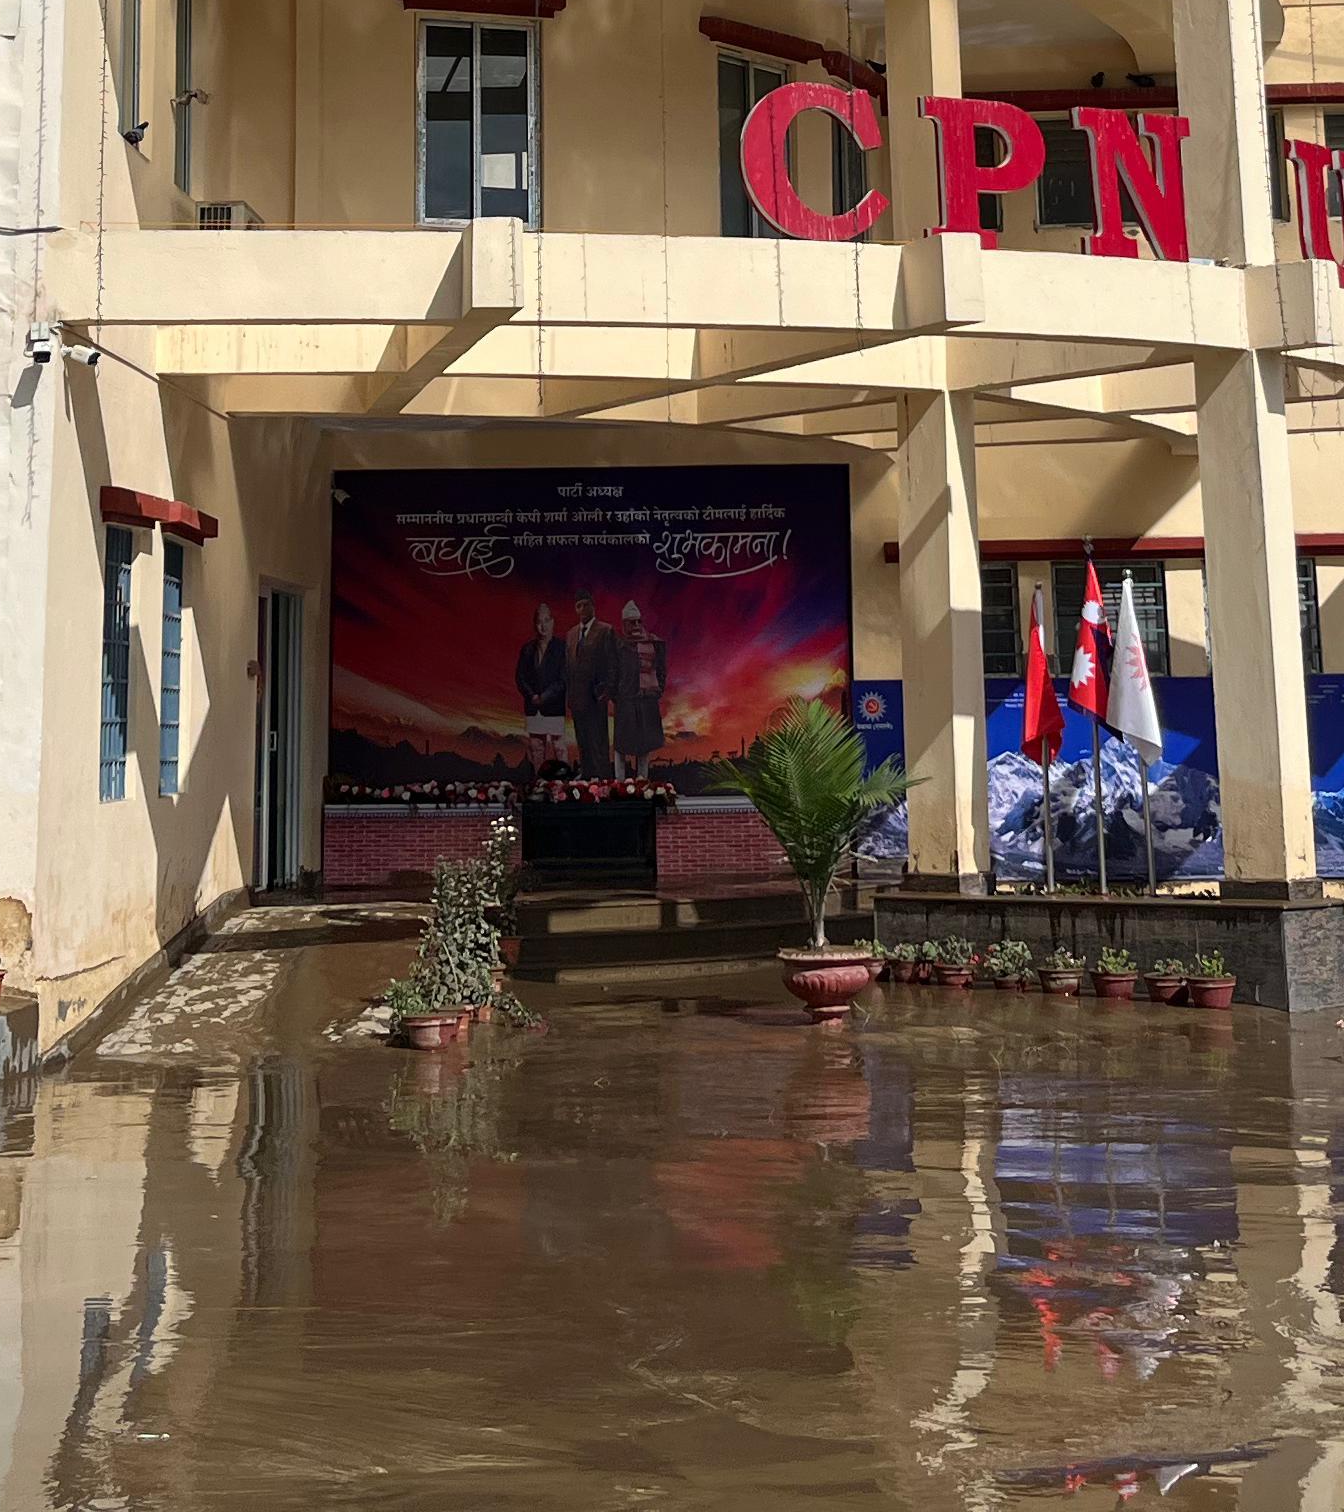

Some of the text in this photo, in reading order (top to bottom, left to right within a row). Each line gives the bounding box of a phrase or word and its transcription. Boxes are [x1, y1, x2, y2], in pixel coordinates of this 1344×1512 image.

[740, 81, 1190, 262] CPN
[557, 482, 624, 498] पार्टी अध्यक्ष
[396, 510, 453, 525] सम्माननीय
[456, 509, 513, 524] प्रधानमन्त्री
[516, 508, 541, 523] केपी
[543, 507, 568, 523] शर्मा
[571, 507, 604, 522] ओली
[749, 503, 785, 520] हार्दिक
[512, 531, 544, 548] सहित
[546, 535, 580, 546] सफल
[581, 529, 651, 546] कार्यकालको
